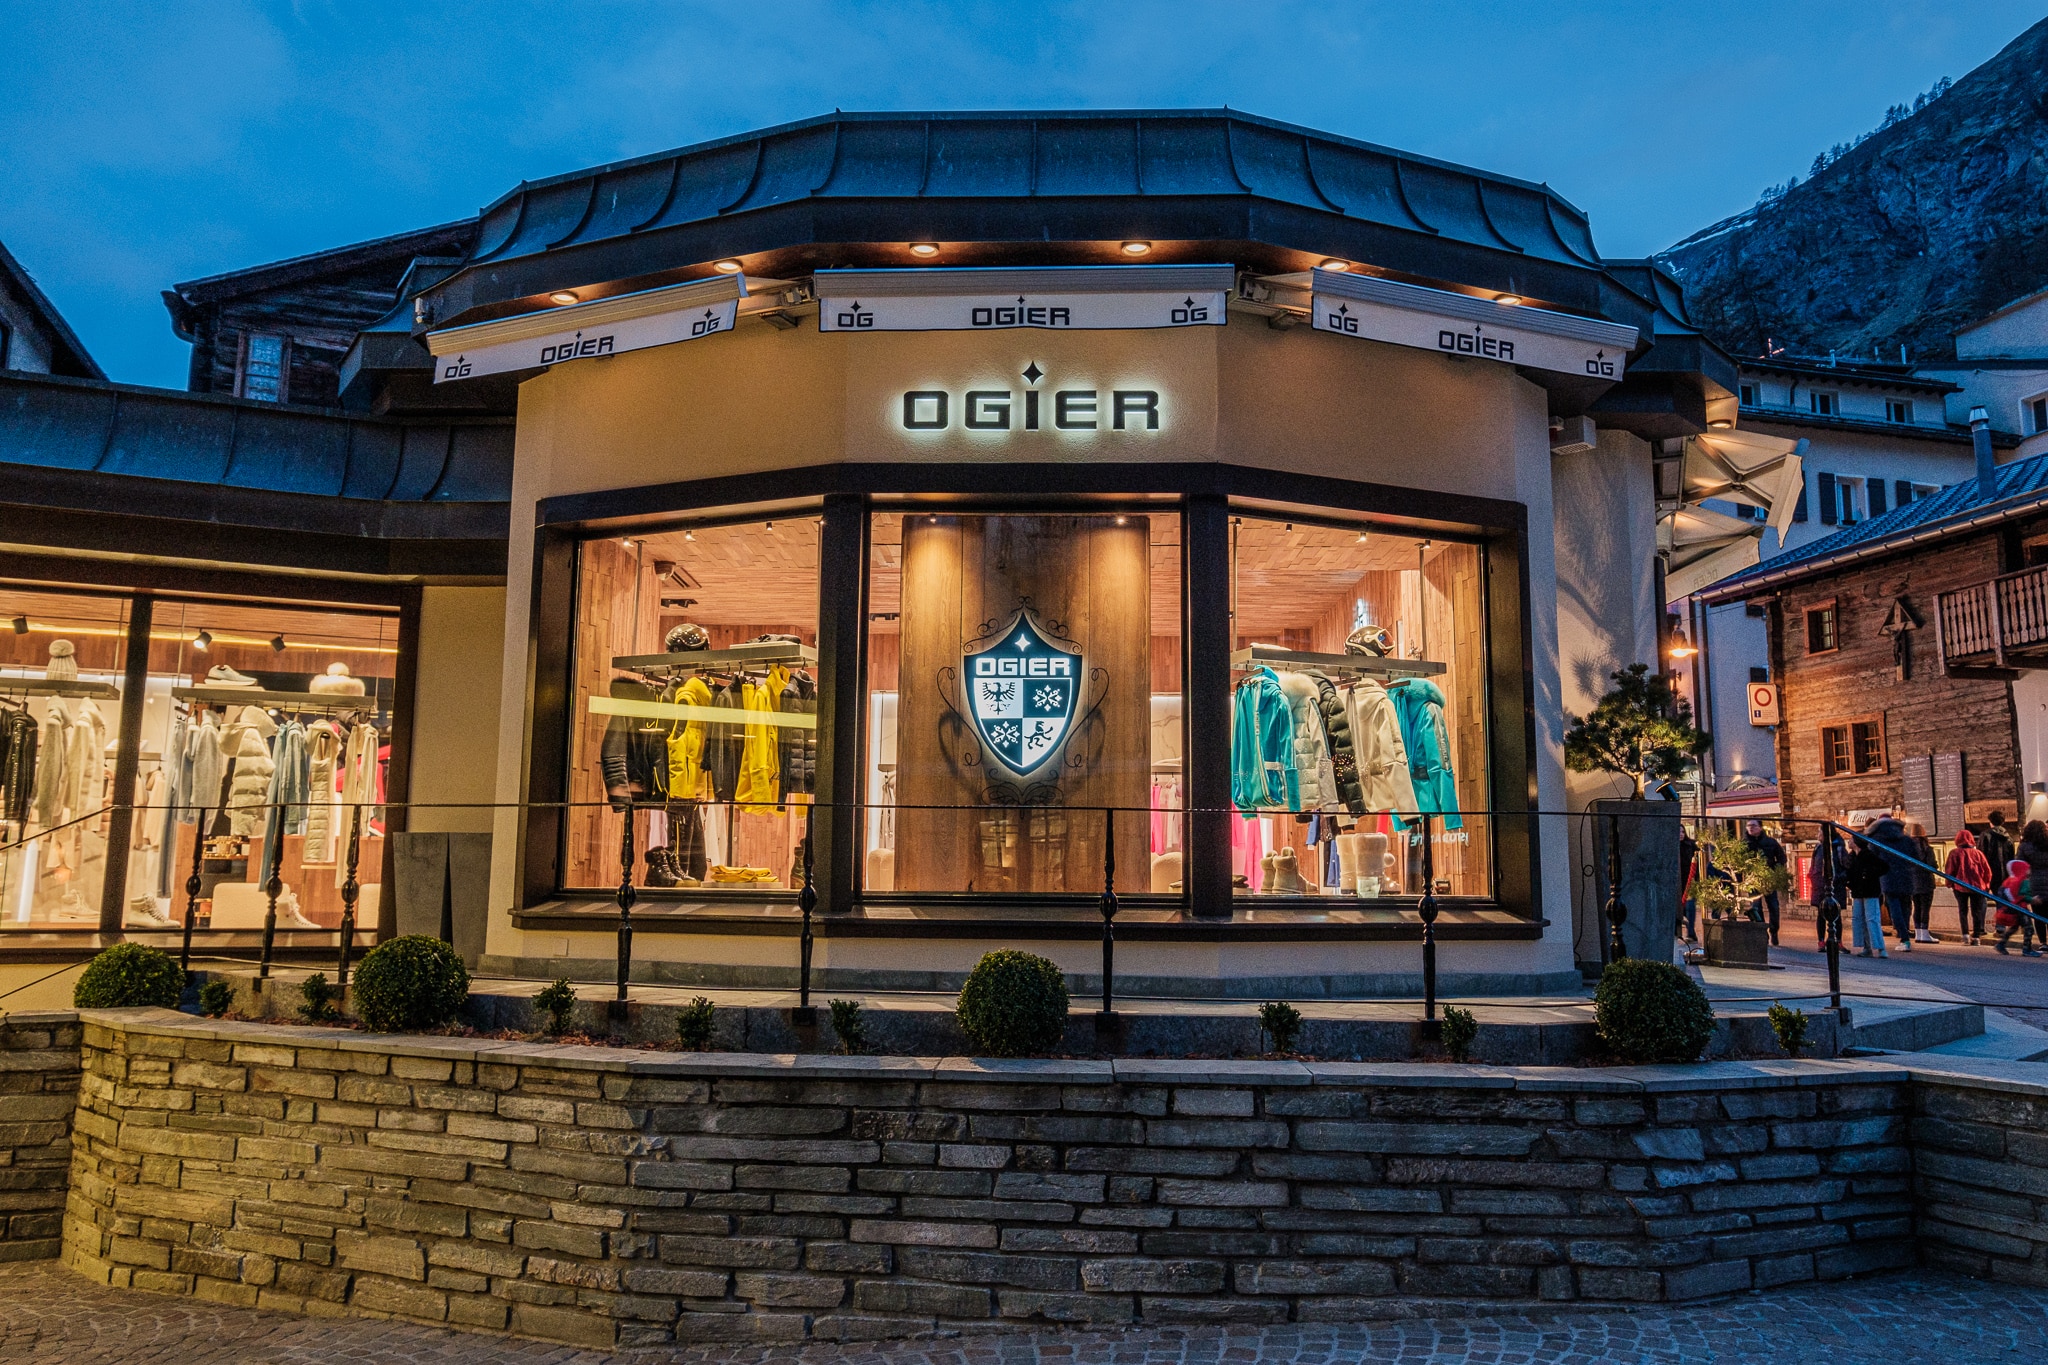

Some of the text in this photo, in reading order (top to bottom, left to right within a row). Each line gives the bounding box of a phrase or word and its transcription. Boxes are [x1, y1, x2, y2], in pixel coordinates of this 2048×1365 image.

[838, 295, 1208, 328] OG OGIER OG
[444, 316, 721, 379] OG OGIER OG
[1328, 312, 1614, 377] OG OGIER OG
[903, 360, 1160, 431] OGIER
[975, 657, 1070, 676] OGIER
